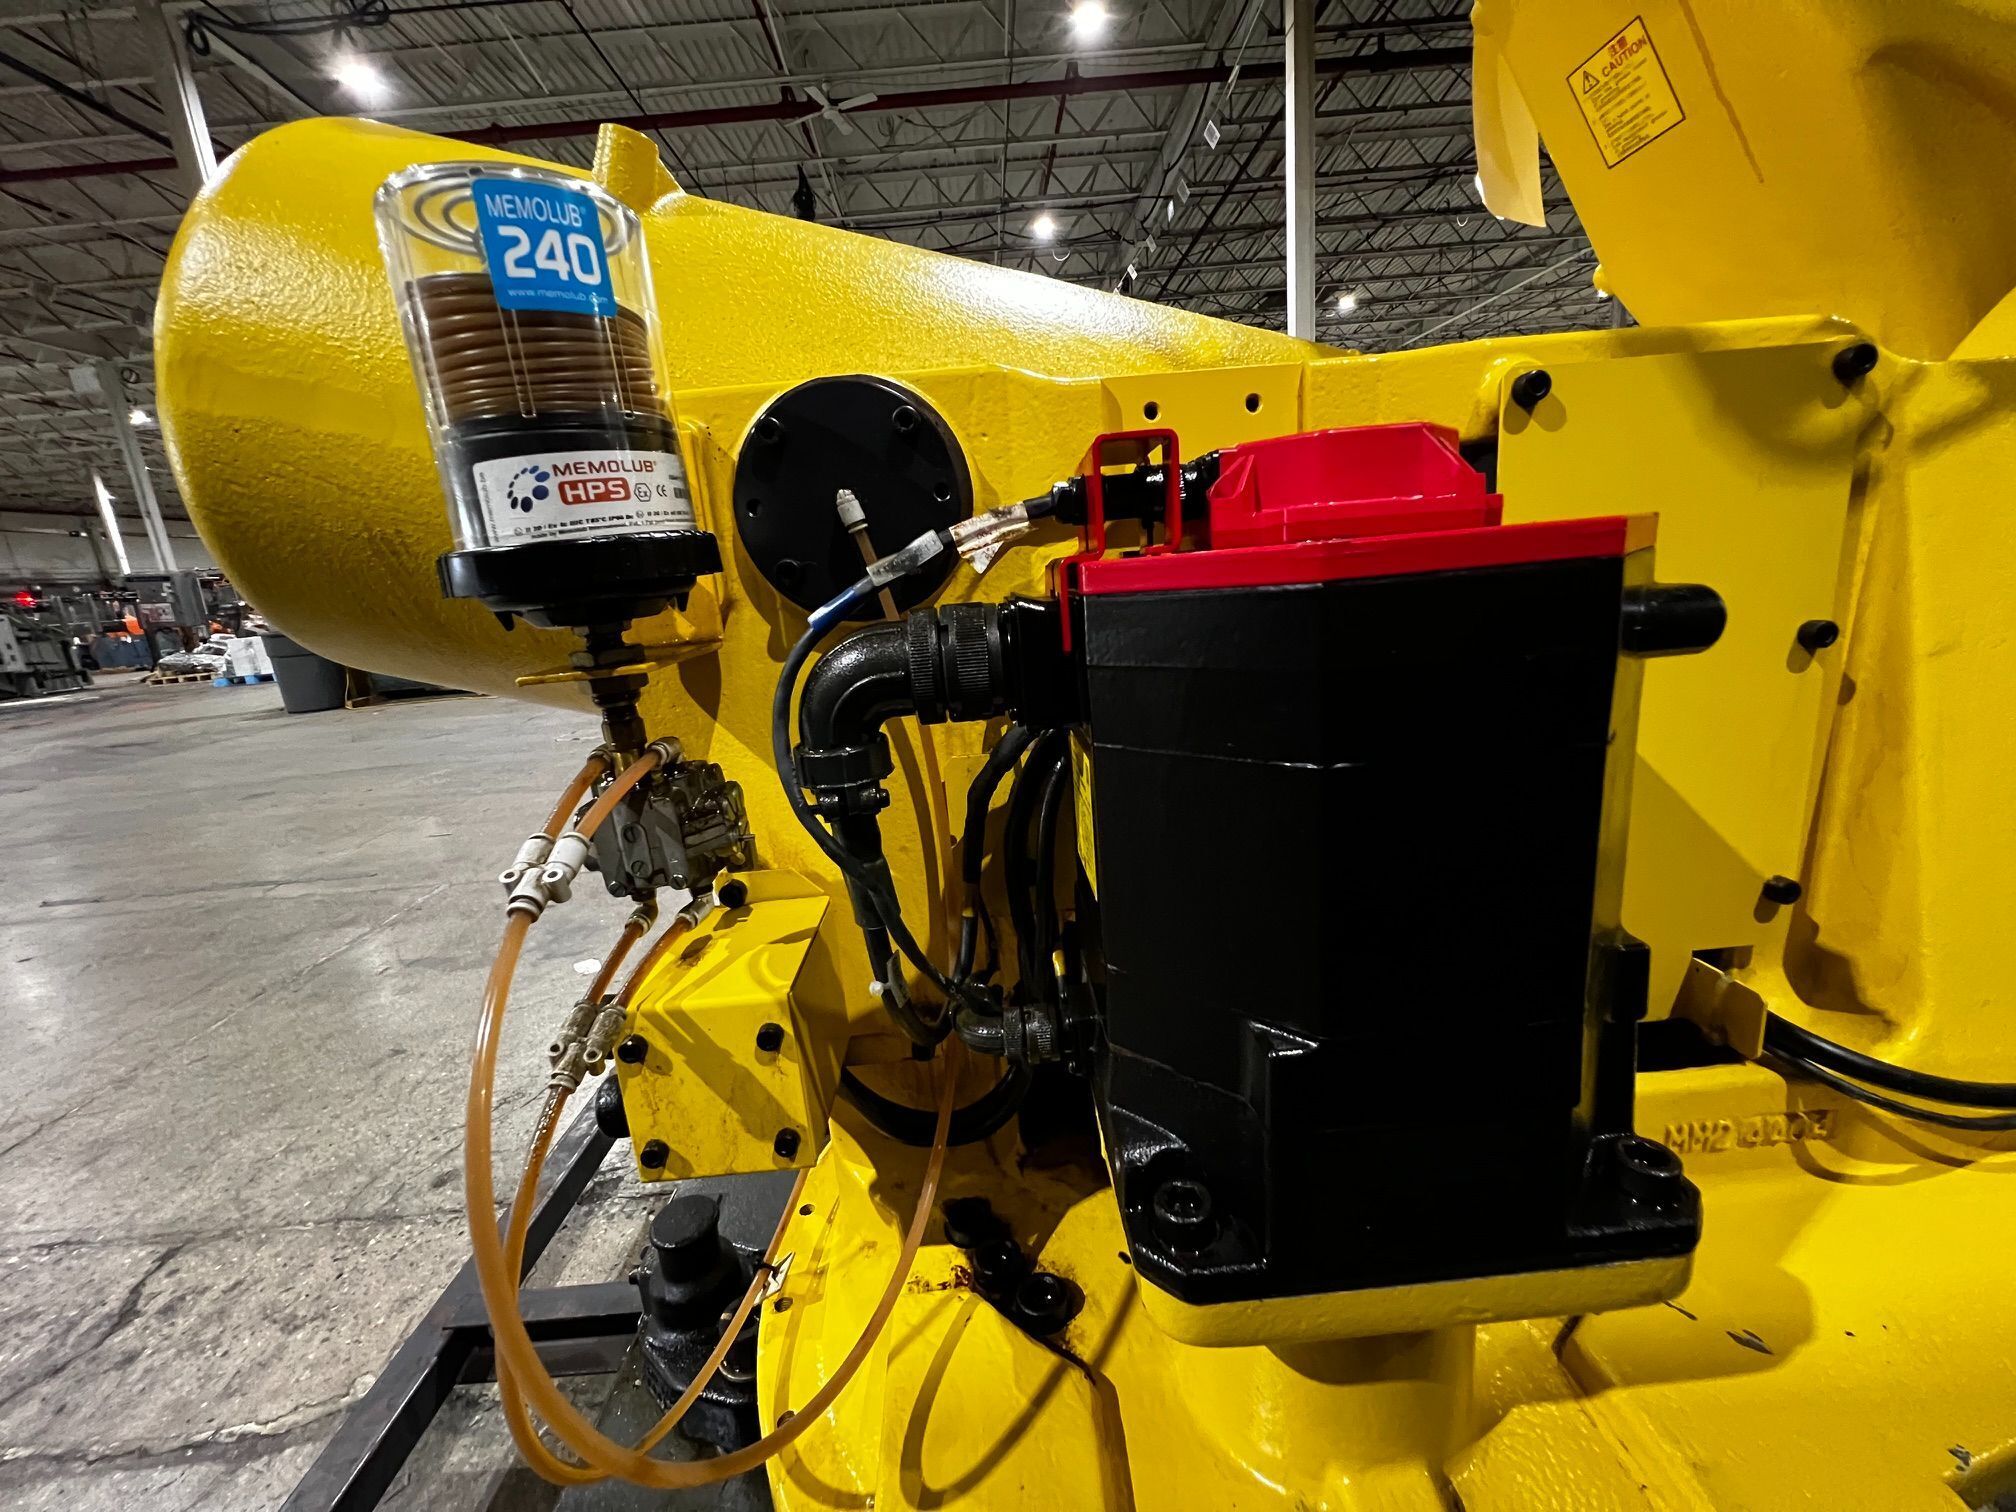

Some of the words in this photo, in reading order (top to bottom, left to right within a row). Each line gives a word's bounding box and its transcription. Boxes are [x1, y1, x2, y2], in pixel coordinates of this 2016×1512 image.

[1602, 35, 1647, 77] CAUTION
[497, 225, 601, 285] 240
[564, 480, 626, 503] HPS
